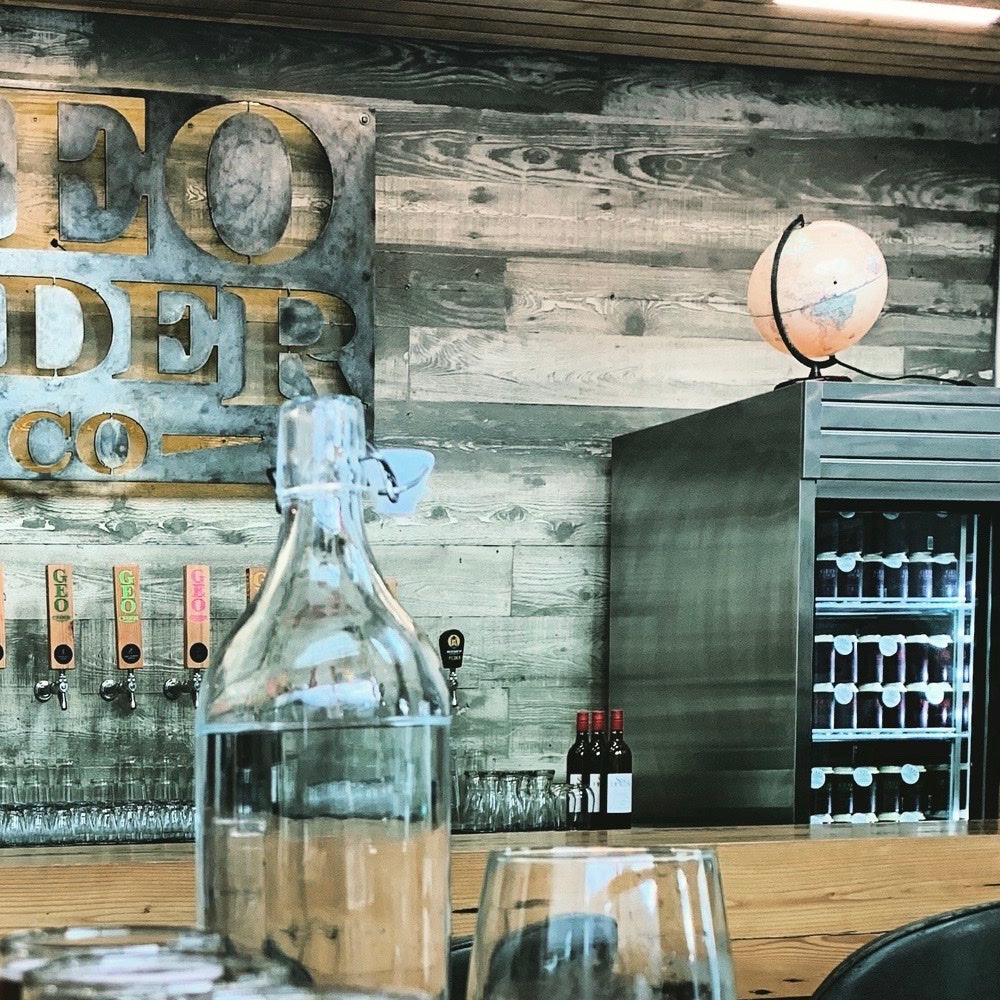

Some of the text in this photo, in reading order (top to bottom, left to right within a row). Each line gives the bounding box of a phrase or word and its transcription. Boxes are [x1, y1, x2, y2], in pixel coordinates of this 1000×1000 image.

[7, 410, 148, 476] CO
[52, 568, 69, 613] GEO
[119, 569, 137, 614] GEO
[190, 569, 206, 613] GEO
